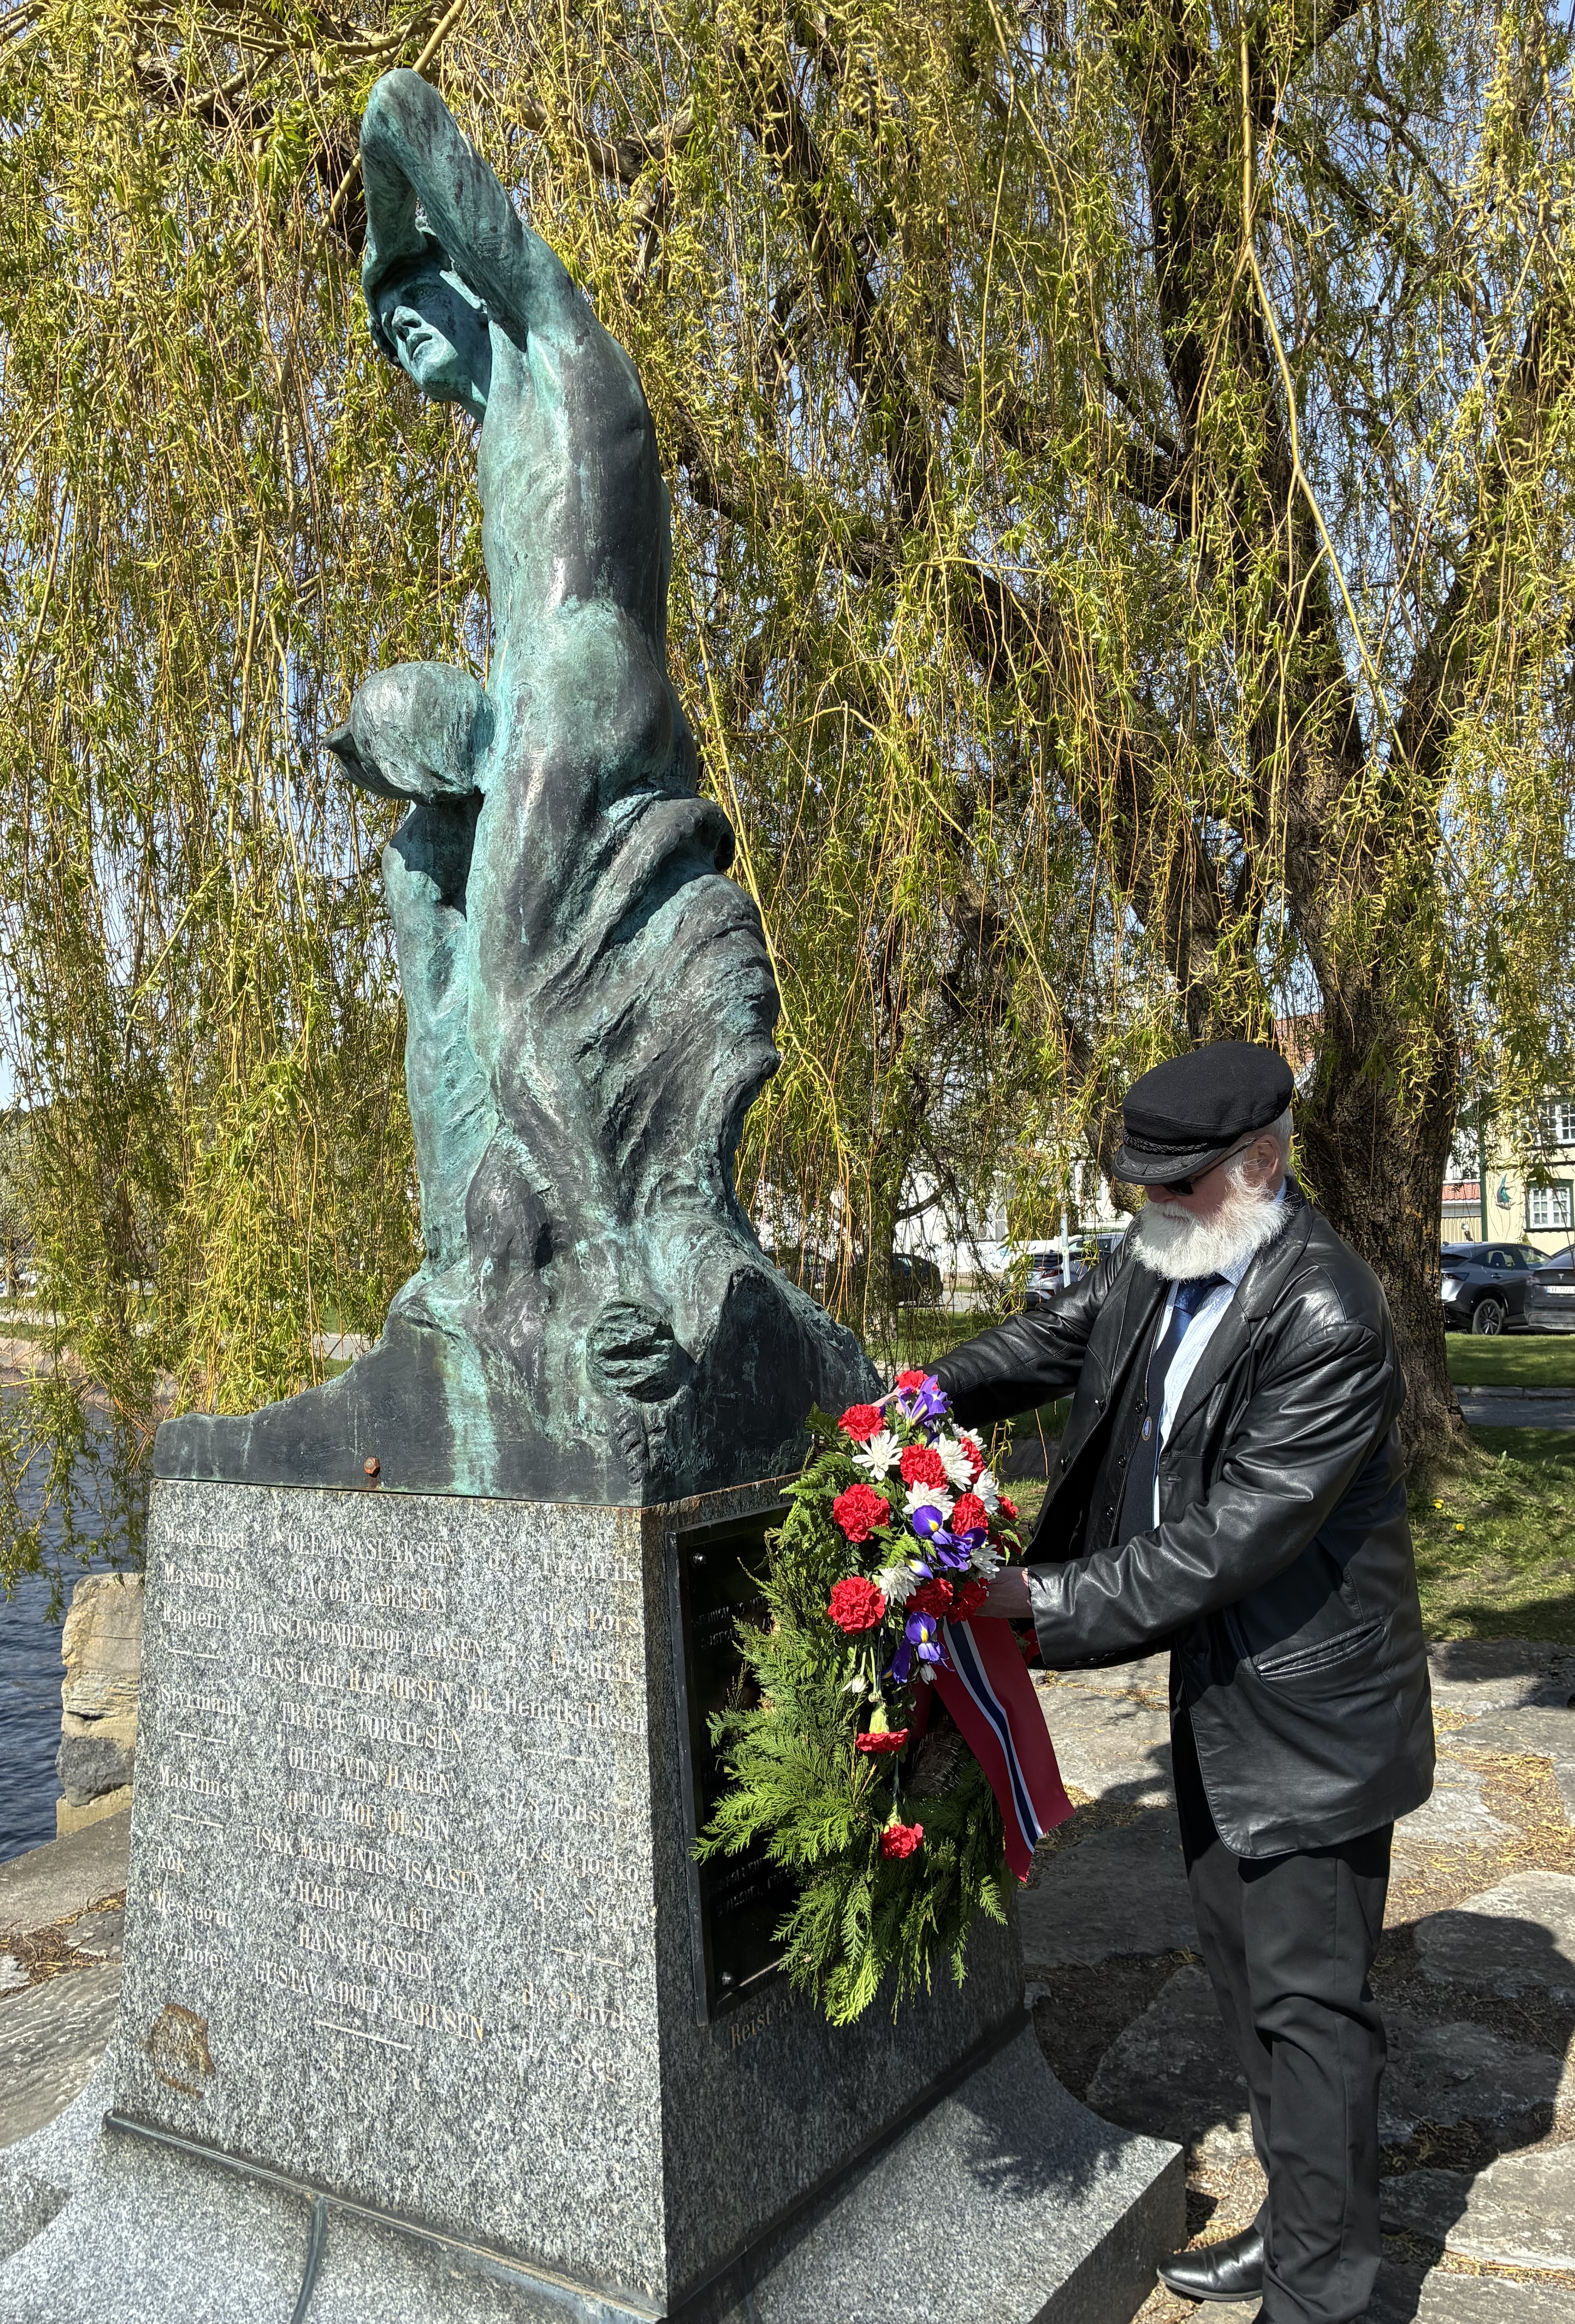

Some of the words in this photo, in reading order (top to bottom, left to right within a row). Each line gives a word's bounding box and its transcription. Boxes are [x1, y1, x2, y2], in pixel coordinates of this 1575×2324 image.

[288, 1531, 321, 1556] OLE
[353, 1536, 455, 1566] ASLAKSEN
[297, 1572, 349, 1603] JACOB
[360, 1581, 447, 1613] KARLSEN
[589, 1605, 640, 1634] Pors
[246, 1613, 288, 1638] HANS
[411, 1631, 483, 1663] LARSEN
[160, 1682, 241, 1716] Styrmand
[279, 1701, 348, 1733] TRYGVE
[357, 1713, 462, 1753] TORKILSEN
[251, 1656, 294, 1682] HANS
[298, 1660, 341, 1689] KARL
[348, 1668, 451, 1705] HALVORSEN
[506, 1690, 578, 1724] Henrik
[587, 1702, 648, 1735] Ibsen
[289, 1746, 321, 1777] OLE
[386, 1763, 451, 1798] HAGEN
[288, 1790, 331, 1818] OTTO
[339, 1800, 376, 1829] MOE
[388, 1809, 450, 1843] OLSEN
[254, 1826, 295, 1856] ISAK
[297, 1834, 397, 1878] MARTINIUS
[404, 1859, 485, 1897] ISAKSEN
[298, 1879, 360, 1914] HARRY
[366, 1895, 434, 1934] WAAGE
[297, 1924, 346, 1958] HANS
[355, 1938, 433, 1982] HANSEN
[254, 1959, 321, 1995] GUSTAV
[323, 1980, 383, 2015] ADOLF
[390, 1994, 485, 2042] KARLSEN
[730, 2001, 771, 2052] Reist
